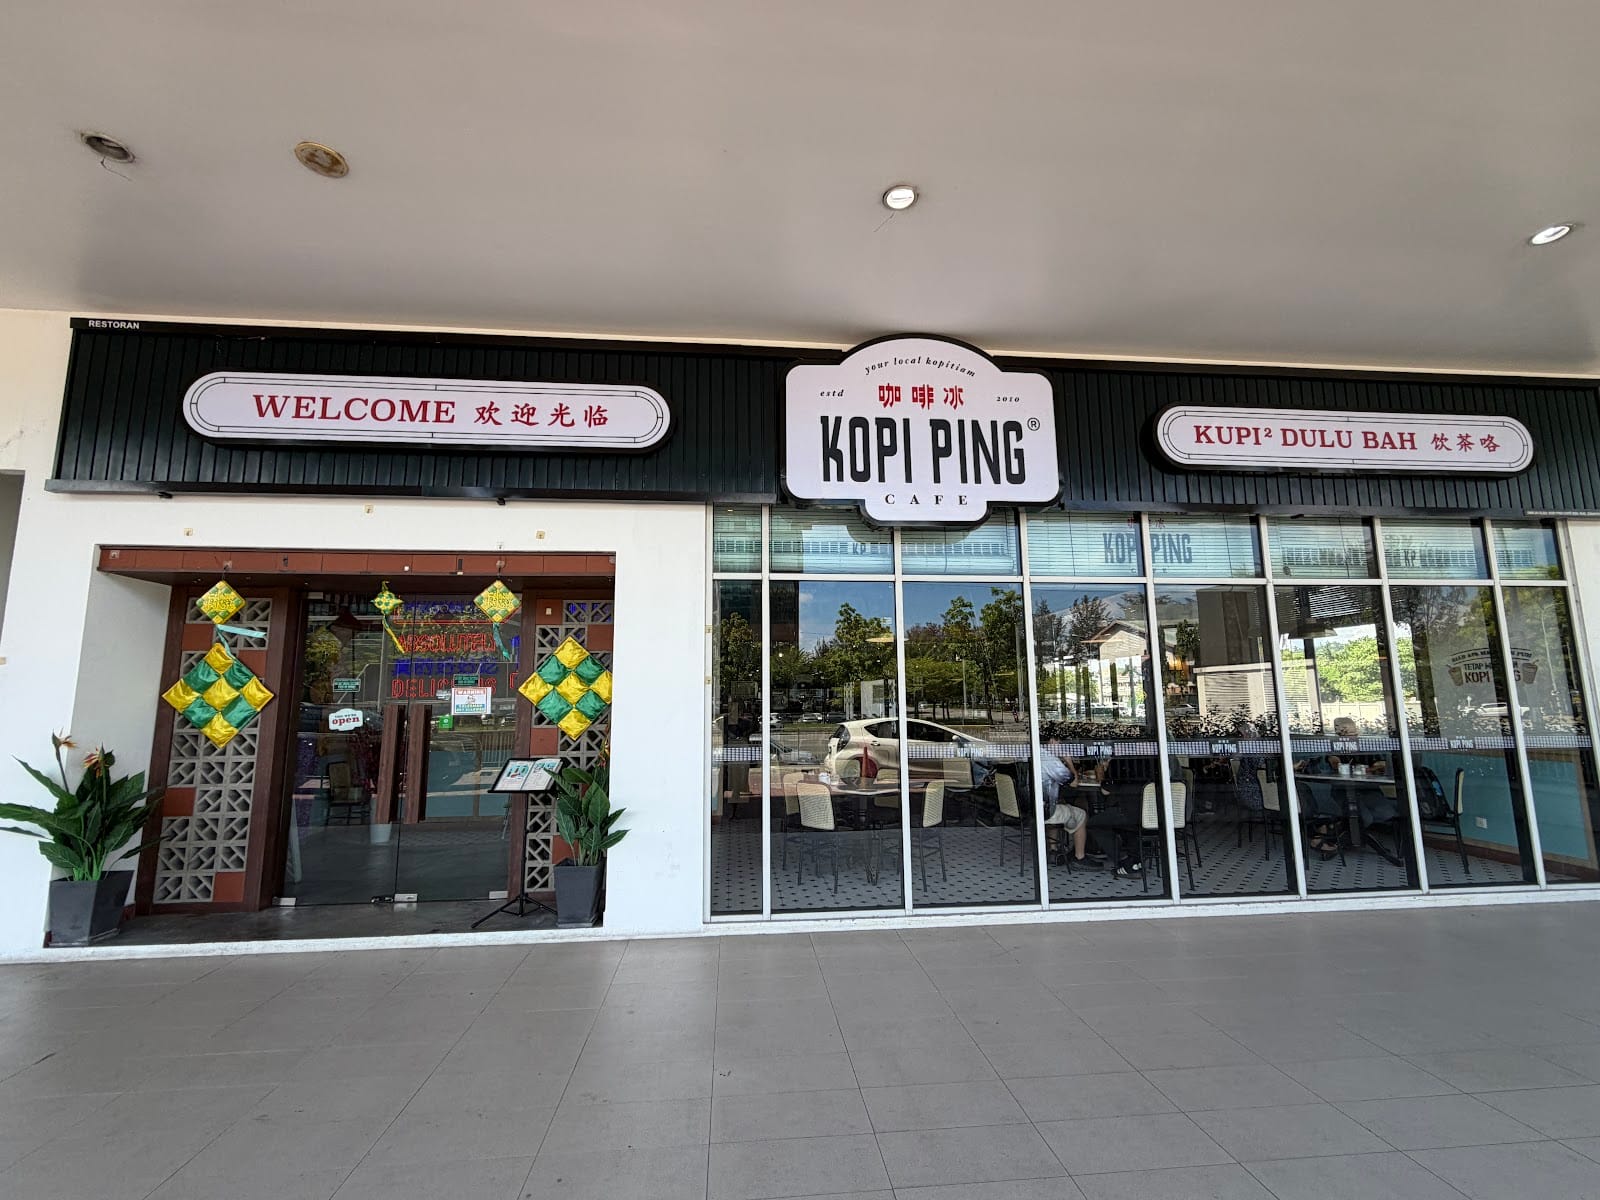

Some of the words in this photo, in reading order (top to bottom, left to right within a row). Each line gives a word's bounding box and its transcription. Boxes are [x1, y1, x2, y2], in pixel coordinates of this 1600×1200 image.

[88, 319, 141, 330] RESTORAN
[864, 360, 890, 376] your
[893, 356, 922, 366] local
[925, 356, 976, 378] kopitiam
[820, 389, 845, 398] estd
[878, 383, 965, 410] 咖啡冰
[253, 394, 456, 424] WELCOME
[474, 400, 609, 428] 欢迎光临
[820, 415, 913, 484] KOPI
[929, 418, 1026, 485] PING
[1280, 428, 1353, 448] DULU
[1362, 431, 1418, 451] BAH
[1430, 433, 1501, 453] 饮茶咯
[884, 494, 968, 506] CAFE
[1103, 532, 1137, 564] KOP
[1150, 533, 1193, 564] PING
[1464, 671, 1490, 683] KOPI
[332, 716, 360, 726] open
